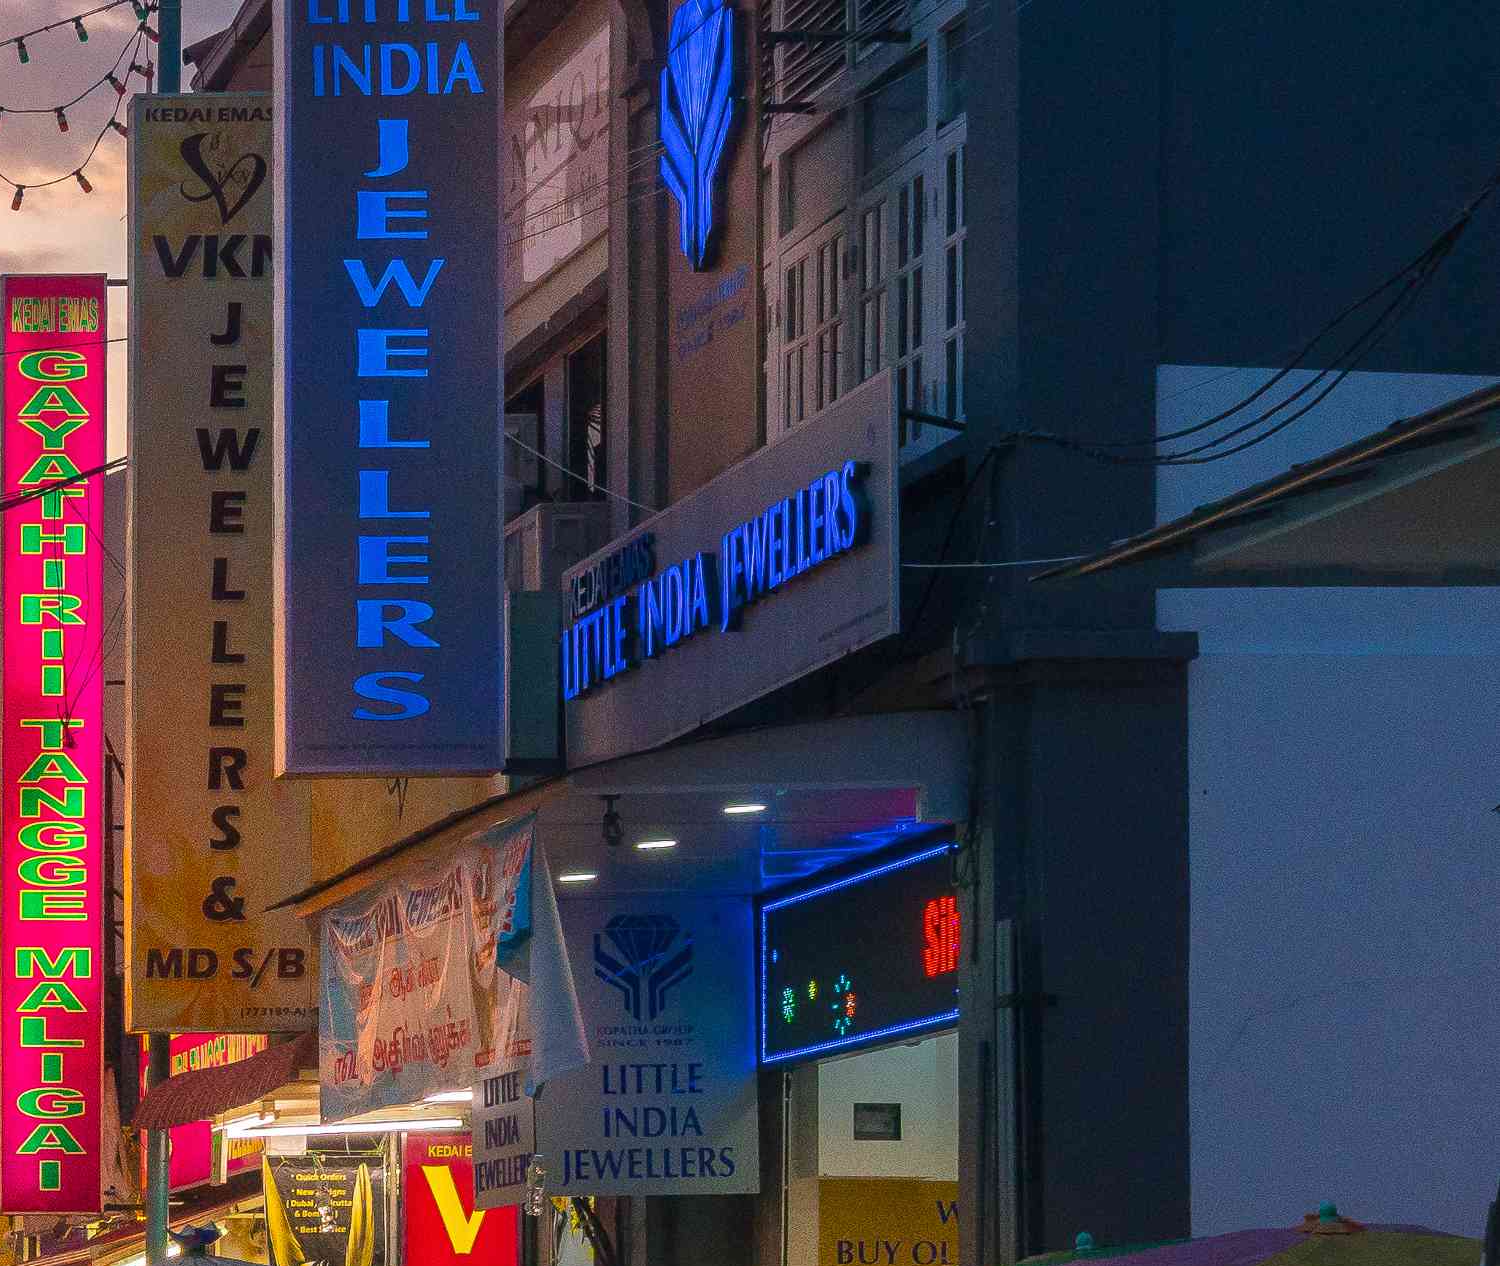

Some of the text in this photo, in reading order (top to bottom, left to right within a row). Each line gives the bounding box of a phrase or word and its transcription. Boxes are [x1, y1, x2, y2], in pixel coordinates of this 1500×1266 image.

[312, 42, 485, 97] INDIA
[145, 107, 212, 122] KEDAI
[11, 296, 99, 333] KEDAI EMAS
[344, 118, 446, 721] JEWELLERS
[561, 460, 857, 702] LITTLE INDIA JEWELLERS
[195, 302, 260, 923] JEWELLERS &
[17, 718, 89, 922] TANGGE
[145, 947, 306, 988] MD S/B
[597, 1039, 648, 1048] SINCE
[15, 946, 92, 1191] MALIGAI
[602, 1063, 702, 1095] LITTLE
[483, 1070, 521, 1109] LITTLE
[484, 1112, 521, 1150] INDIA
[602, 1106, 704, 1138] INDIA
[427, 1144, 465, 1157] KEDAI
[562, 1146, 736, 1186] JEWELLERS
[837, 1239, 900, 1265] BUY
